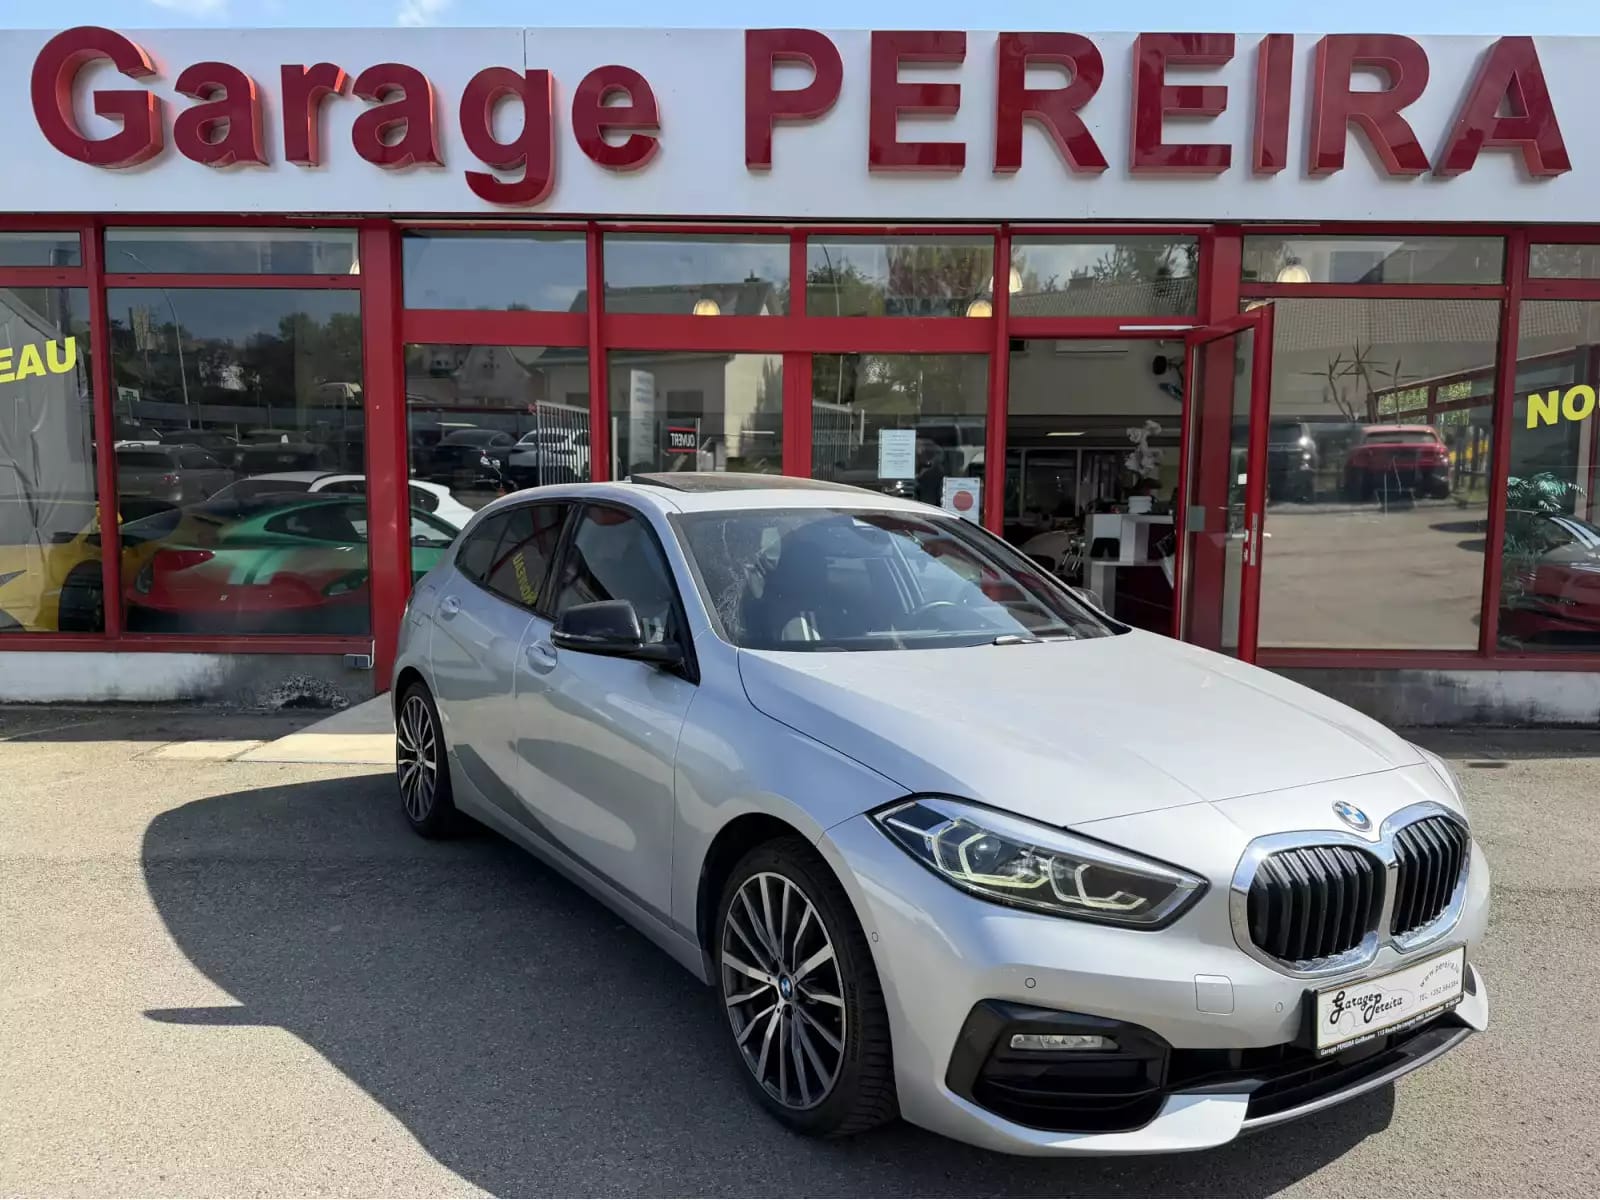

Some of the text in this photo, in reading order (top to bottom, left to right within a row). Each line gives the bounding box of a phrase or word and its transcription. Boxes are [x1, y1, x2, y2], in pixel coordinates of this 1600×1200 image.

[30, 26, 1572, 206] Garage PEREIRA
[1329, 990, 1375, 1025] Garage
[1363, 993, 1403, 1024] Pereira
